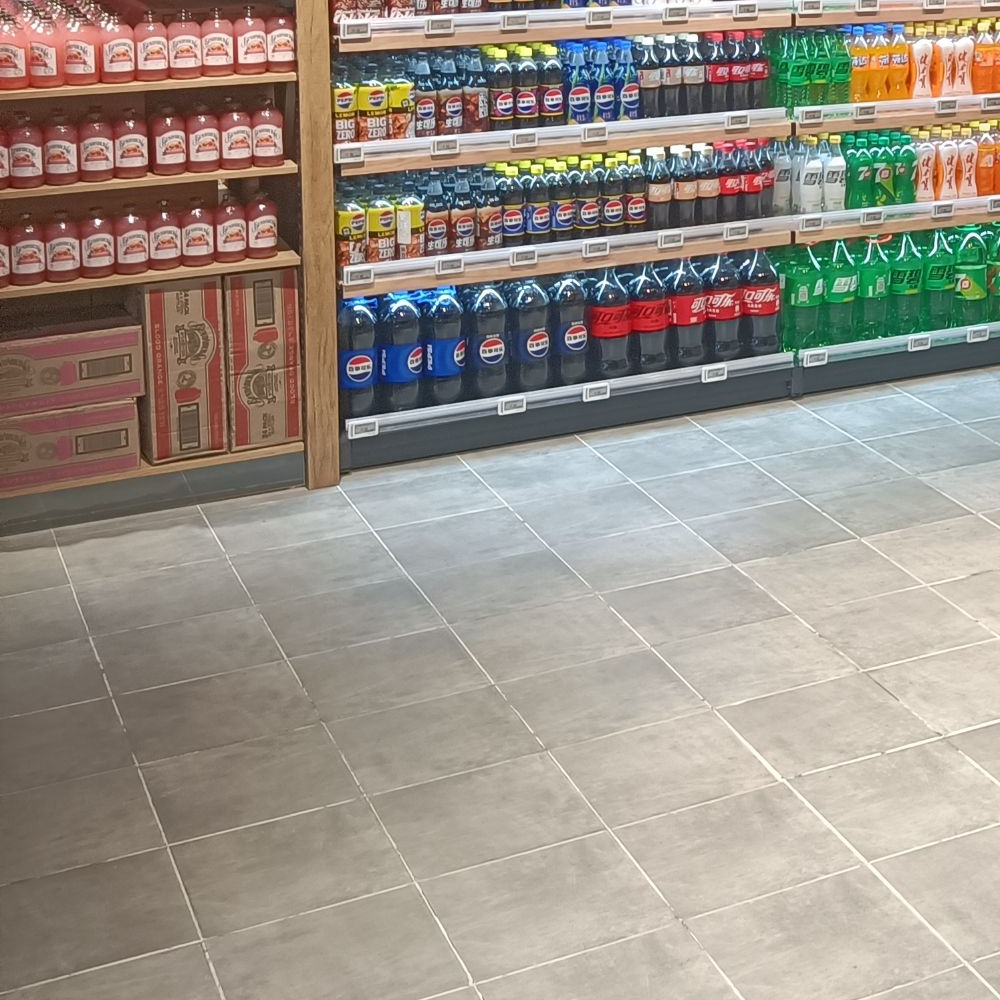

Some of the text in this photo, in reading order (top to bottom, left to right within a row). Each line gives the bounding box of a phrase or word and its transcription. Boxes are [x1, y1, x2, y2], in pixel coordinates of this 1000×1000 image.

[335, 118, 355, 129] BIG
[366, 117, 387, 128] BIG
[336, 129, 356, 140] ZERO
[367, 128, 387, 138] ZERO
[154, 323, 162, 351] BLOOD
